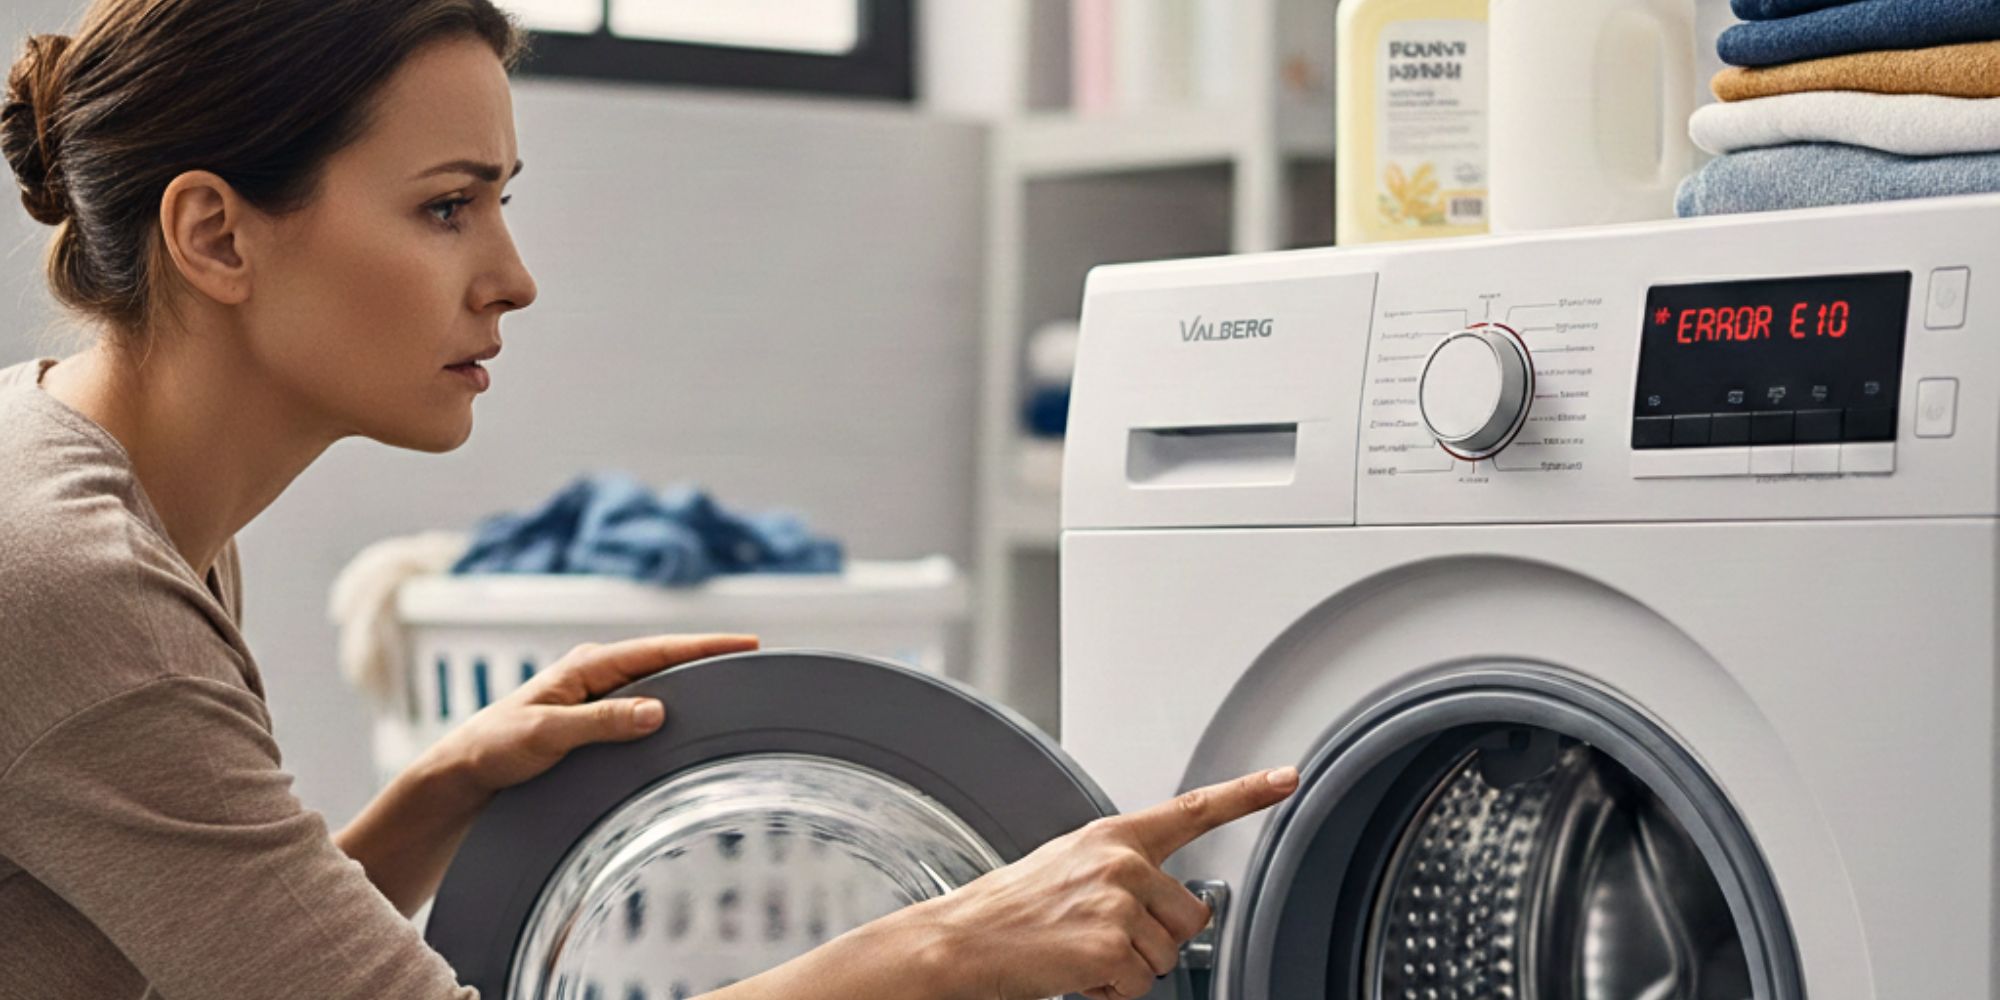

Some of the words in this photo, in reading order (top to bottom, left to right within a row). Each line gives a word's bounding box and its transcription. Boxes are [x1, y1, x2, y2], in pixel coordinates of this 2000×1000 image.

[1180, 315, 1273, 342] VALBERG
[1677, 305, 1773, 344] ERROR
[1789, 300, 1849, 339] E10
